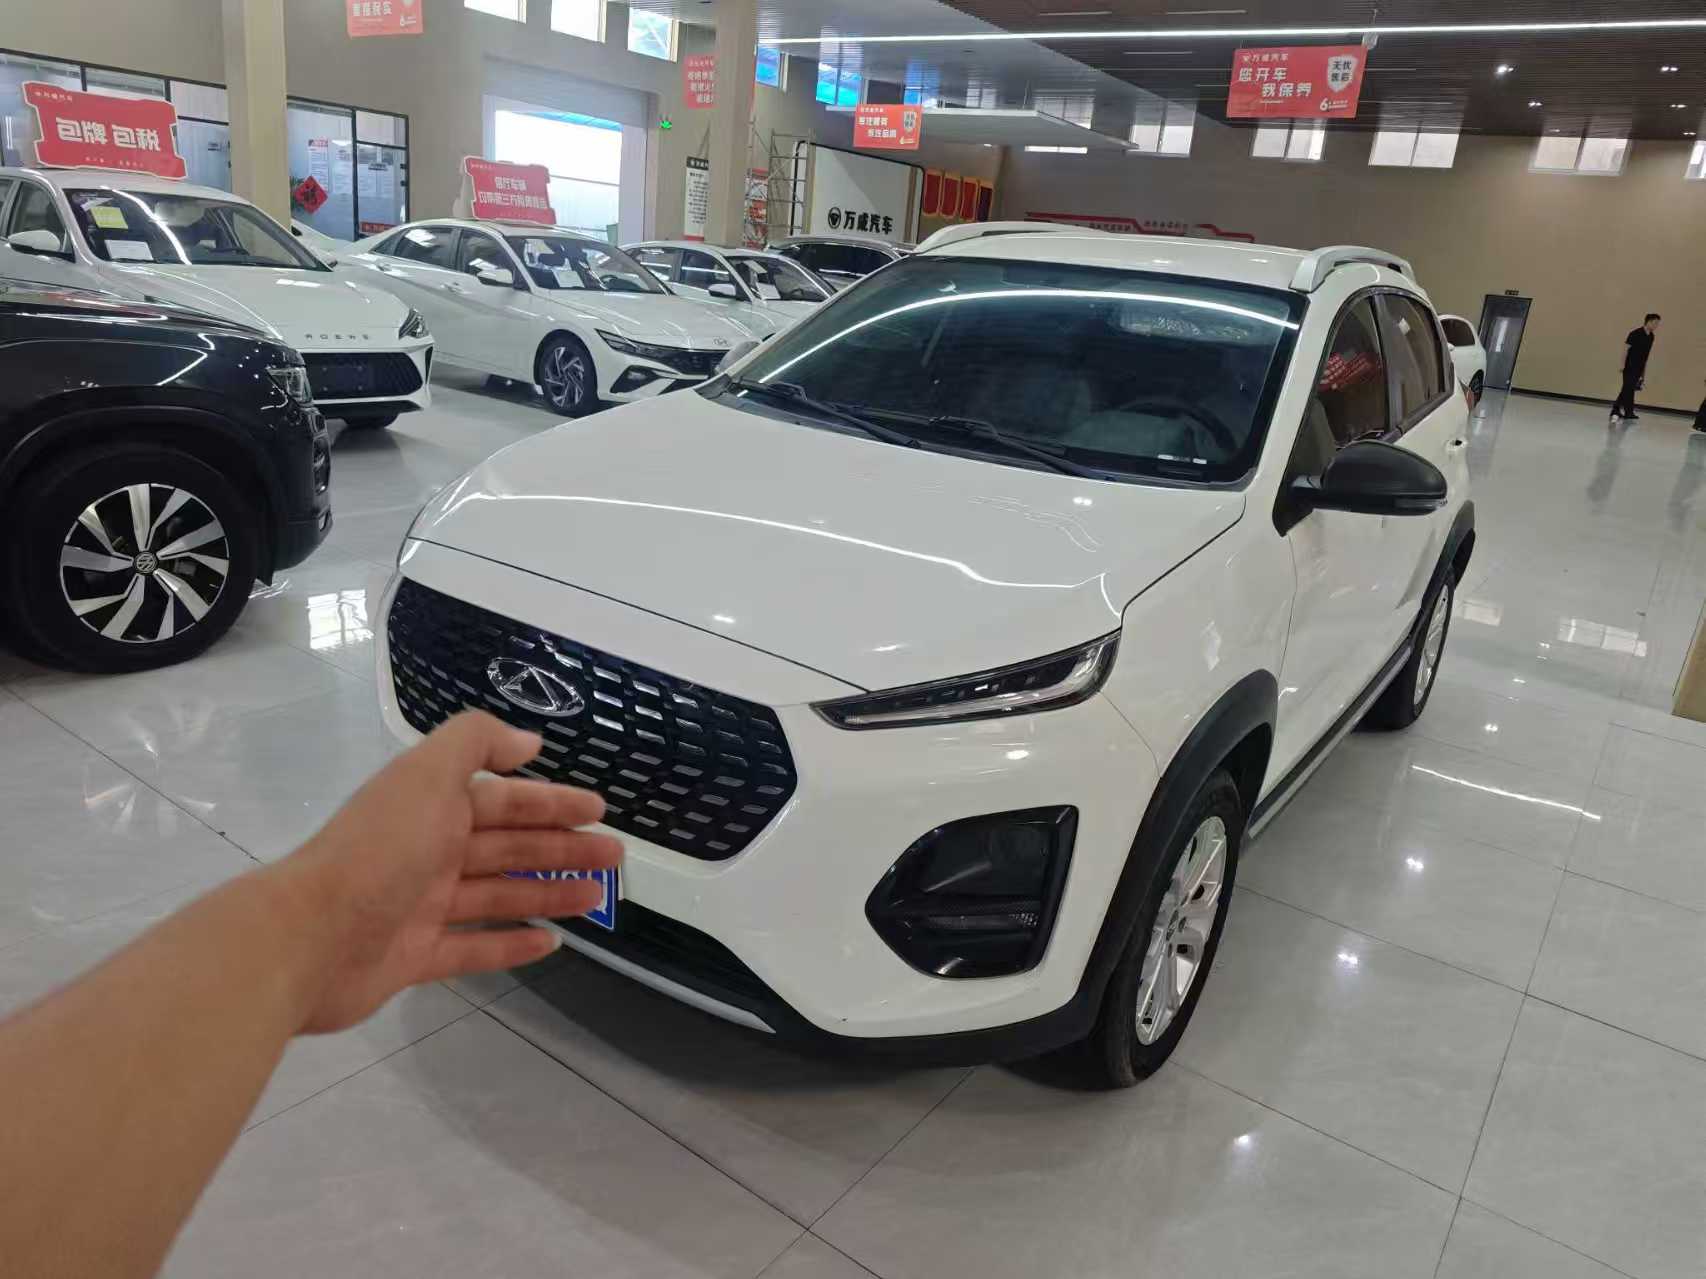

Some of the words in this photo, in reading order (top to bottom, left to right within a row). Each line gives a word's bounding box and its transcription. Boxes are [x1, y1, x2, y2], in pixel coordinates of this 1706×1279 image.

[1239, 67, 1288, 82] 您开车
[1261, 82, 1313, 98] 我保养
[56, 117, 107, 145] 包牌
[111, 124, 161, 151] 包税
[843, 210, 894, 235] 万威汽车
